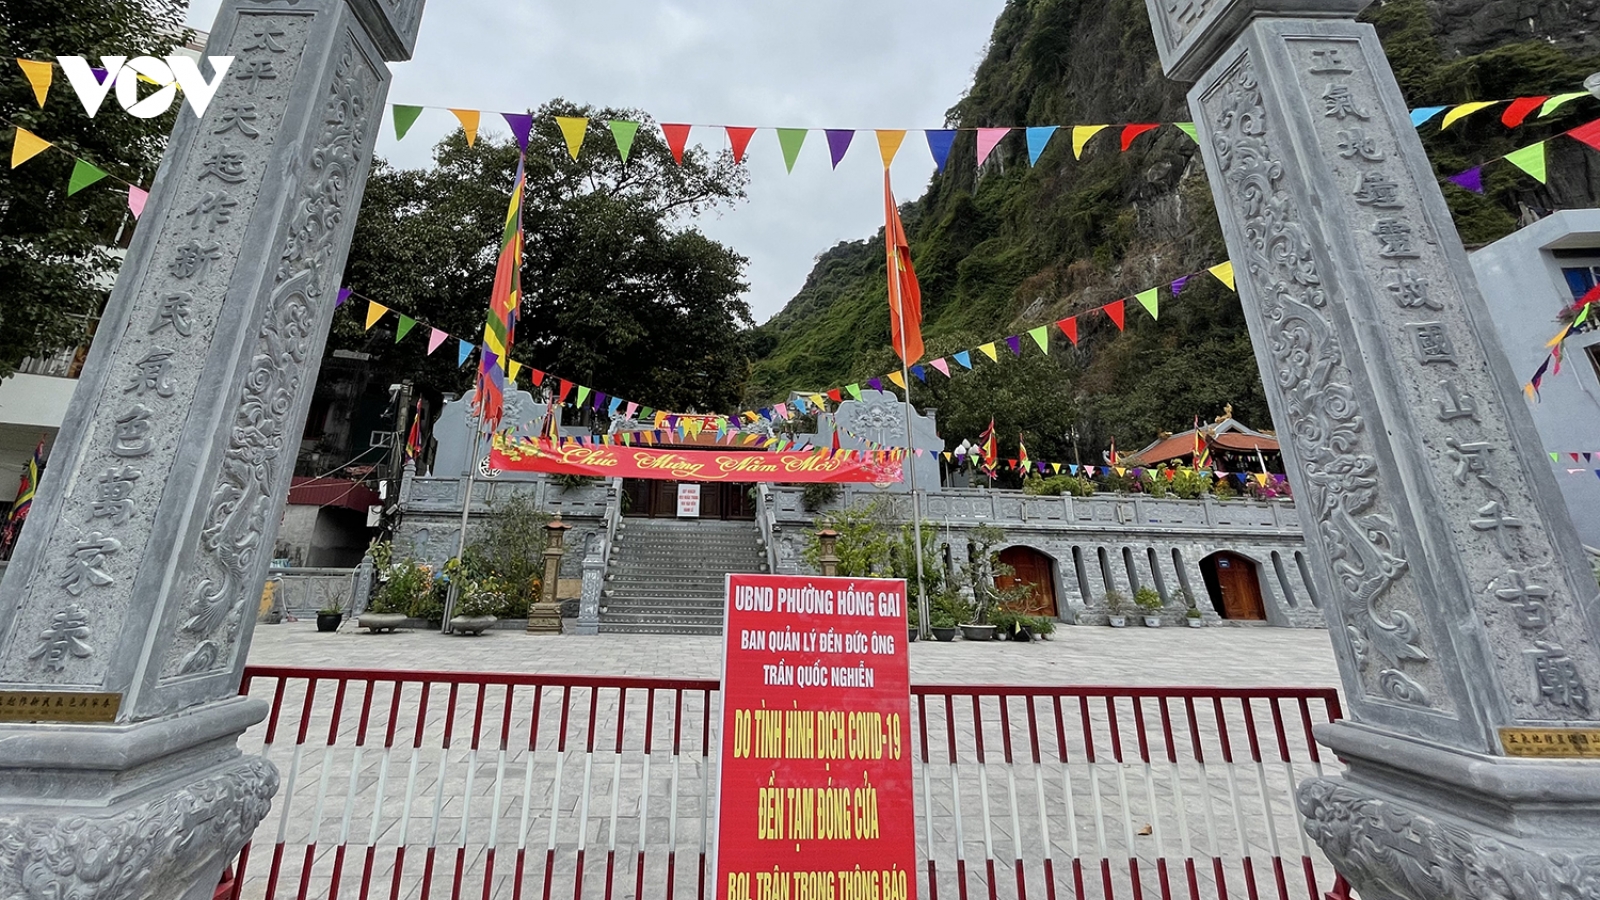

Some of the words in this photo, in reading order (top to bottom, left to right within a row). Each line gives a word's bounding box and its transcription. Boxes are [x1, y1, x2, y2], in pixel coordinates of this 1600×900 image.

[556, 444, 618, 466] Chúc
[633, 452, 729, 479] Mừng
[715, 456, 778, 472] Năm
[735, 585, 773, 612] UBND
[777, 583, 833, 615] PHƯỜNG
[837, 582, 875, 617] HỒNG
[878, 592, 901, 618] GAI
[741, 630, 766, 650] BAN
[768, 625, 800, 652] QUẢN
[803, 628, 817, 653] LÝ
[819, 627, 843, 653] ĐỀN
[845, 630, 868, 654] ĐỨC
[871, 631, 895, 655] ÔNG
[763, 658, 794, 686] TRẦN
[797, 659, 828, 688] QUỐC
[831, 660, 875, 688] NGHIỄN
[734, 709, 751, 758] DO
[754, 699, 783, 759] TÌNH
[785, 699, 814, 759] HÌNH
[817, 710, 846, 771] DỊCH
[848, 711, 901, 760] COVID-19
[758, 770, 784, 840] ĐỀN
[787, 787, 814, 853] TẠM
[817, 776, 851, 840] ĐÓNG
[854, 770, 880, 840] CỬA
[755, 864, 790, 900] TRÂN
[838, 863, 879, 900] THÔNG
[881, 862, 908, 900] BÁO
